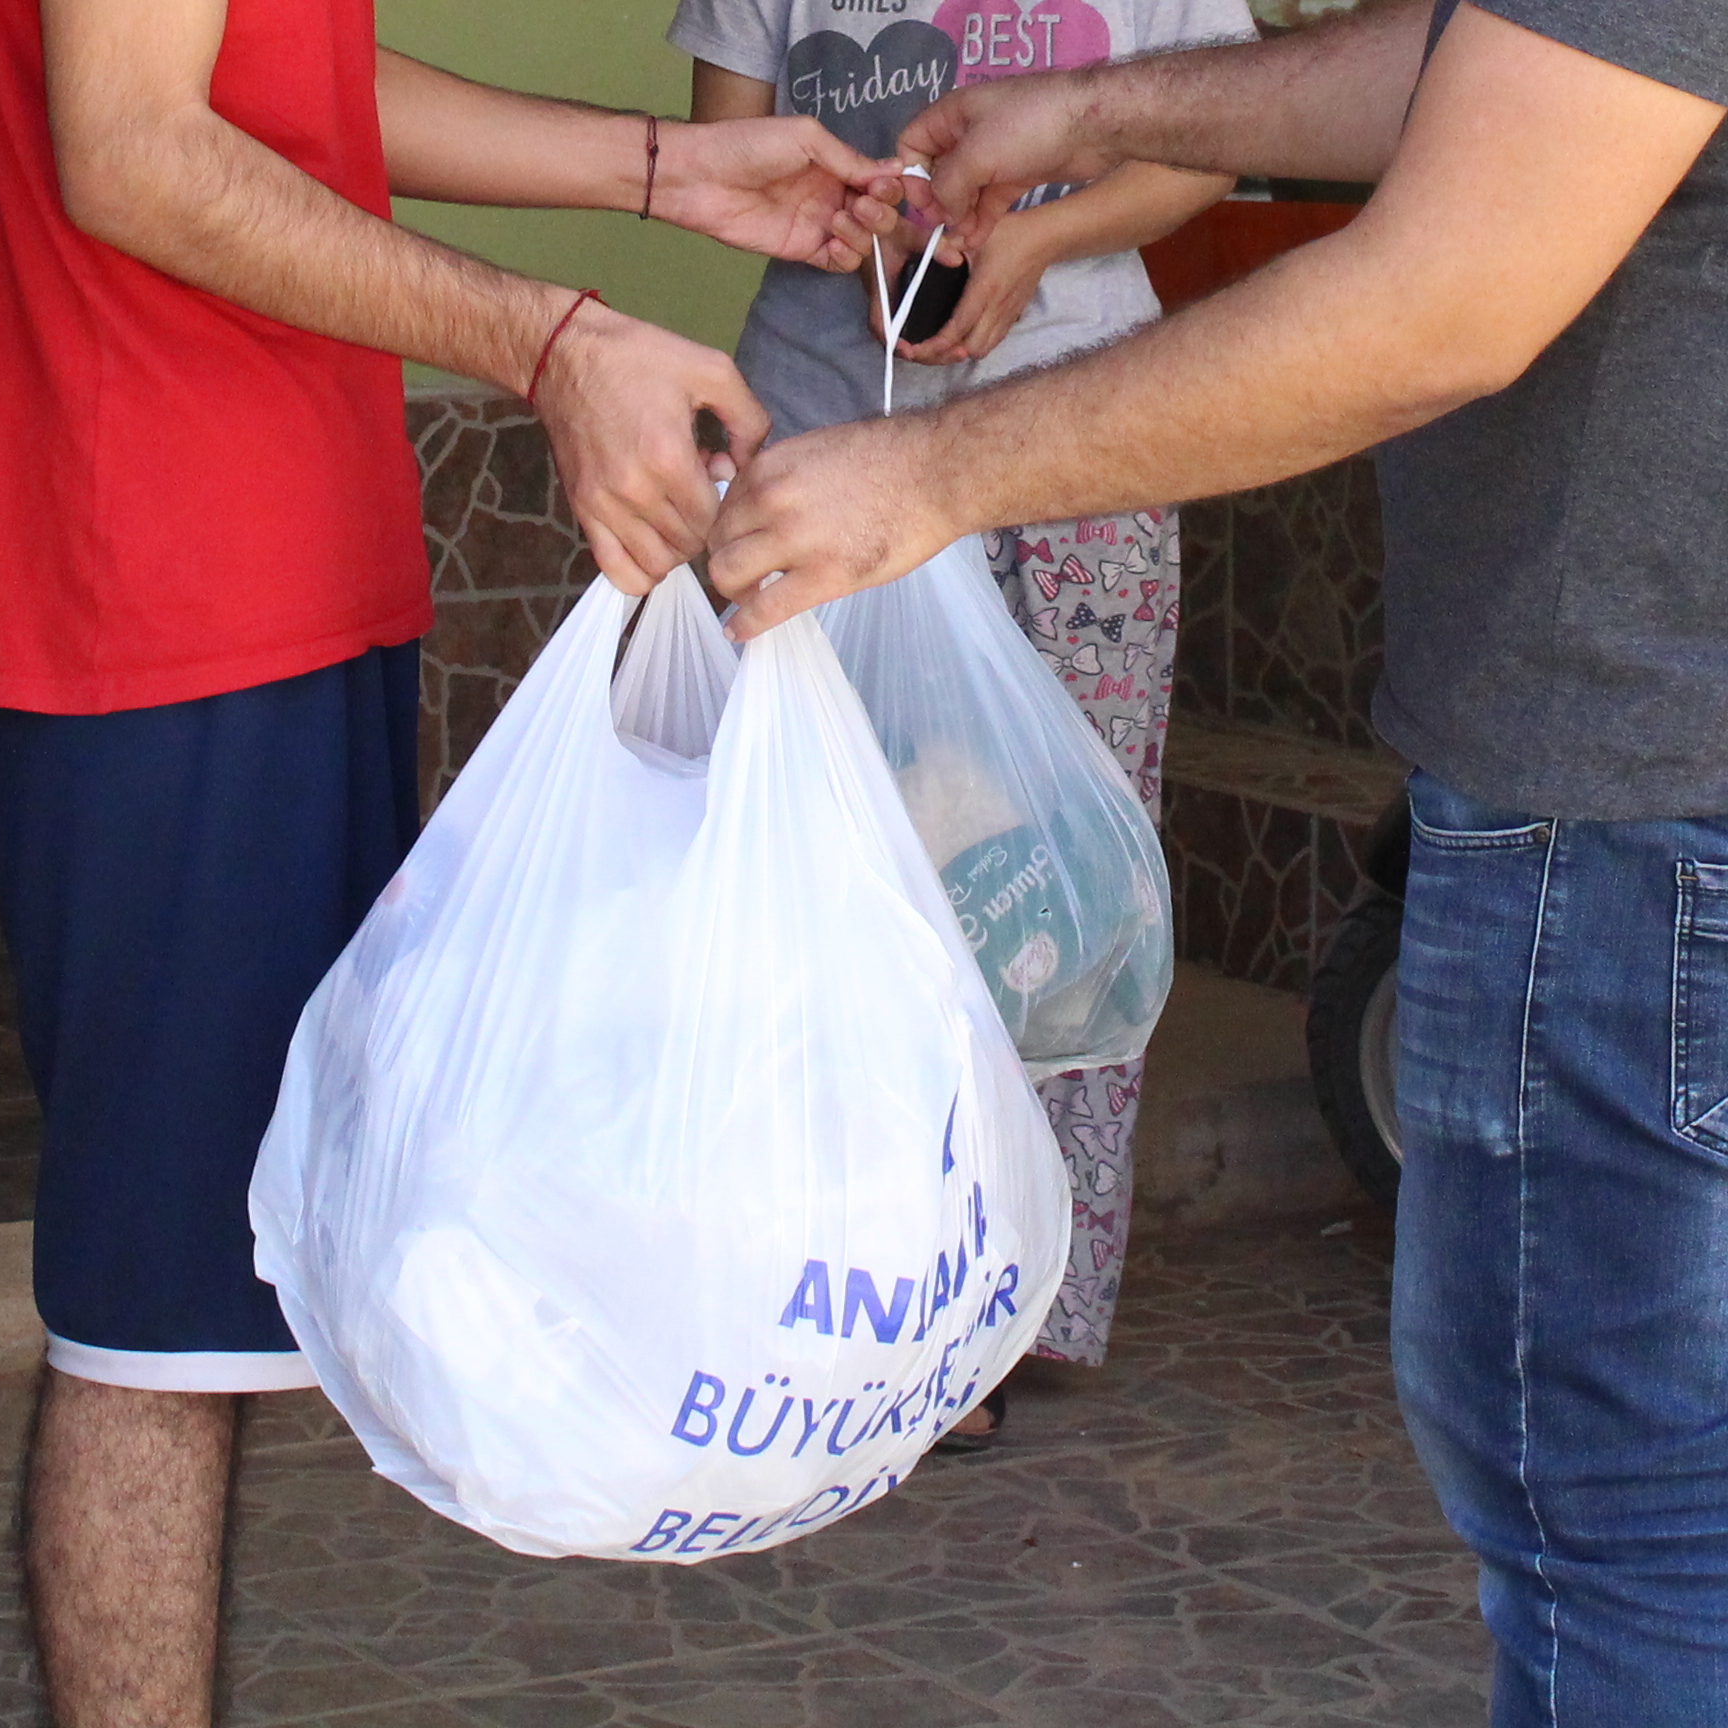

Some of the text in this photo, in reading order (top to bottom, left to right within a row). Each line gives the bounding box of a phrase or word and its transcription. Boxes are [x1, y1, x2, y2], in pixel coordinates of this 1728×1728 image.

[961, 12, 1062, 68] BEST
[792, 54, 949, 120] Friday
[671, 1262, 1020, 1459] BÜYÜKŞEİR
